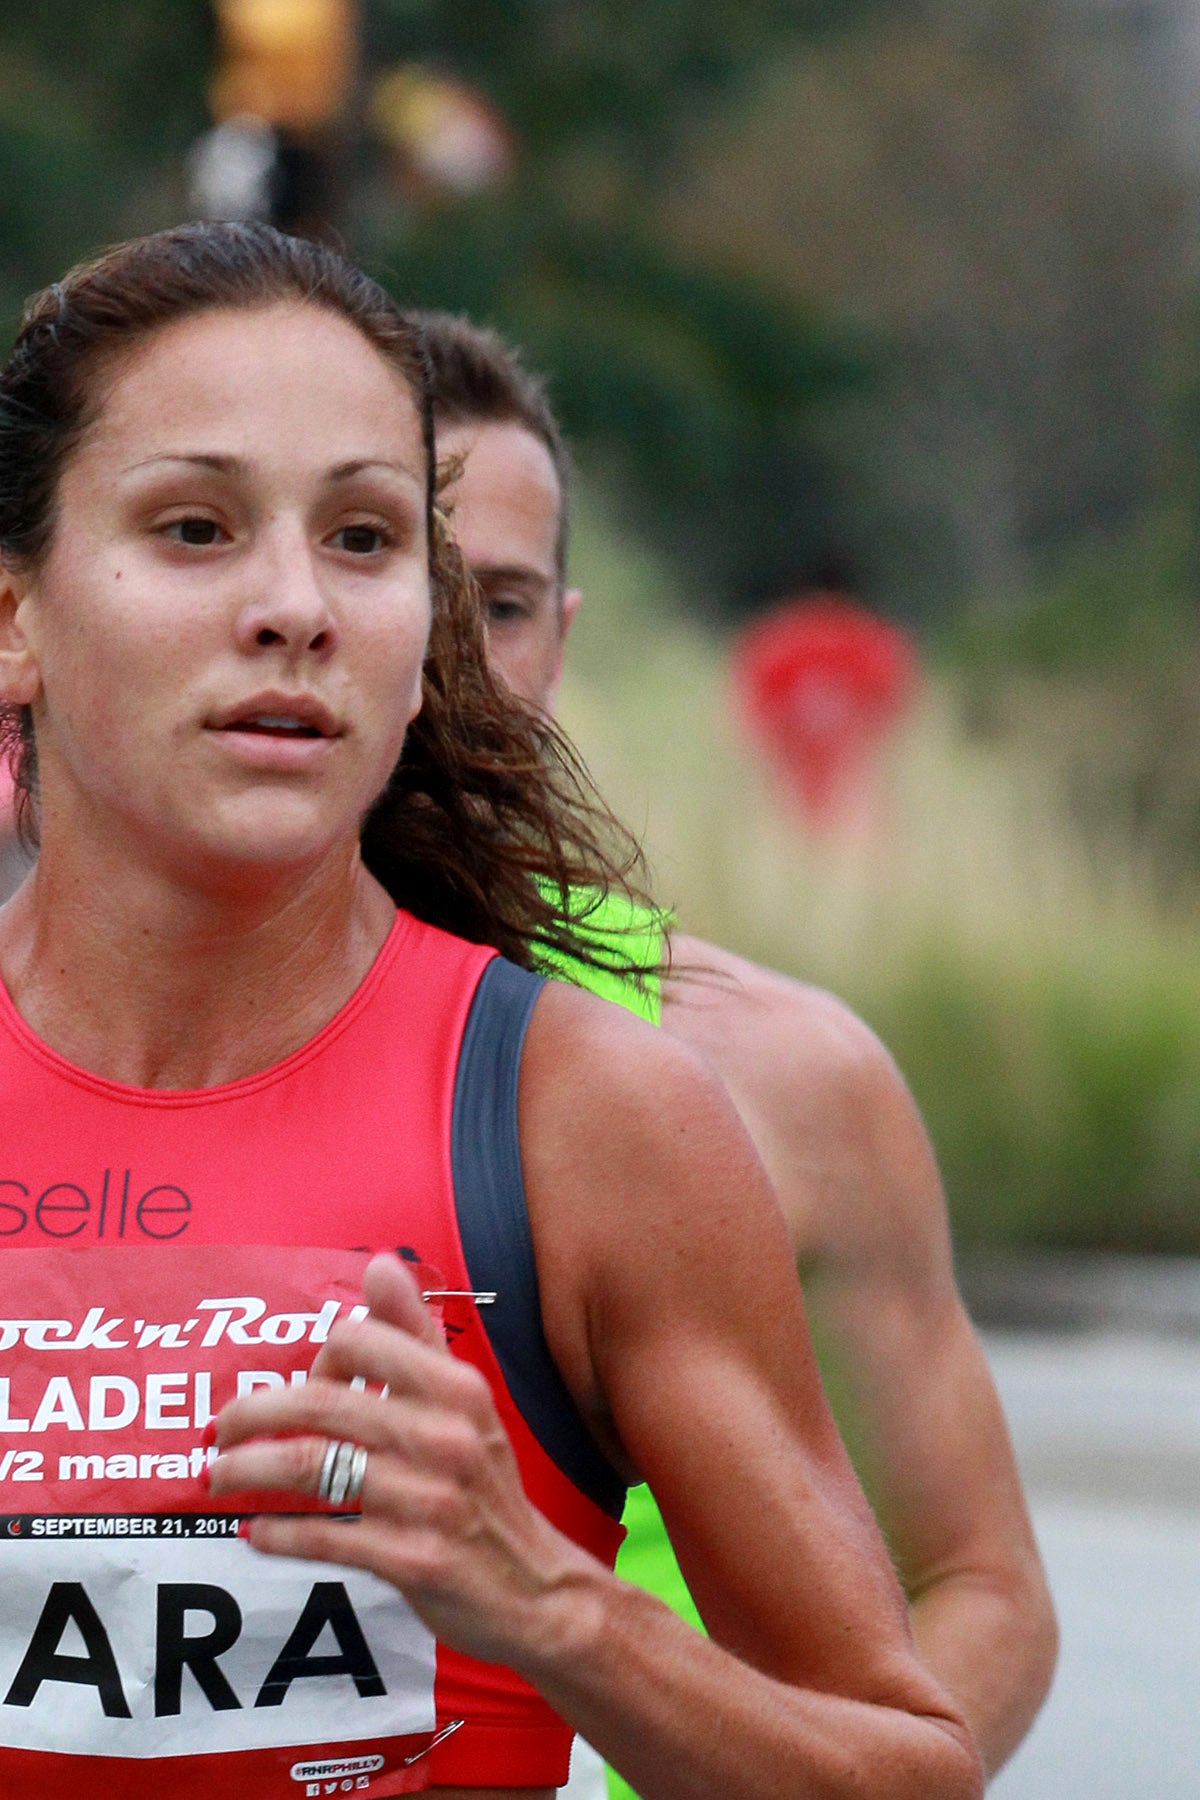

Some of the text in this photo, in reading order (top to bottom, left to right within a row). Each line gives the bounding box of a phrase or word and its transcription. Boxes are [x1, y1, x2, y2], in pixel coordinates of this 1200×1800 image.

[58, 1446, 221, 1481] marat
[31, 1518, 239, 1538] SEPTEMBER 21, 2014
